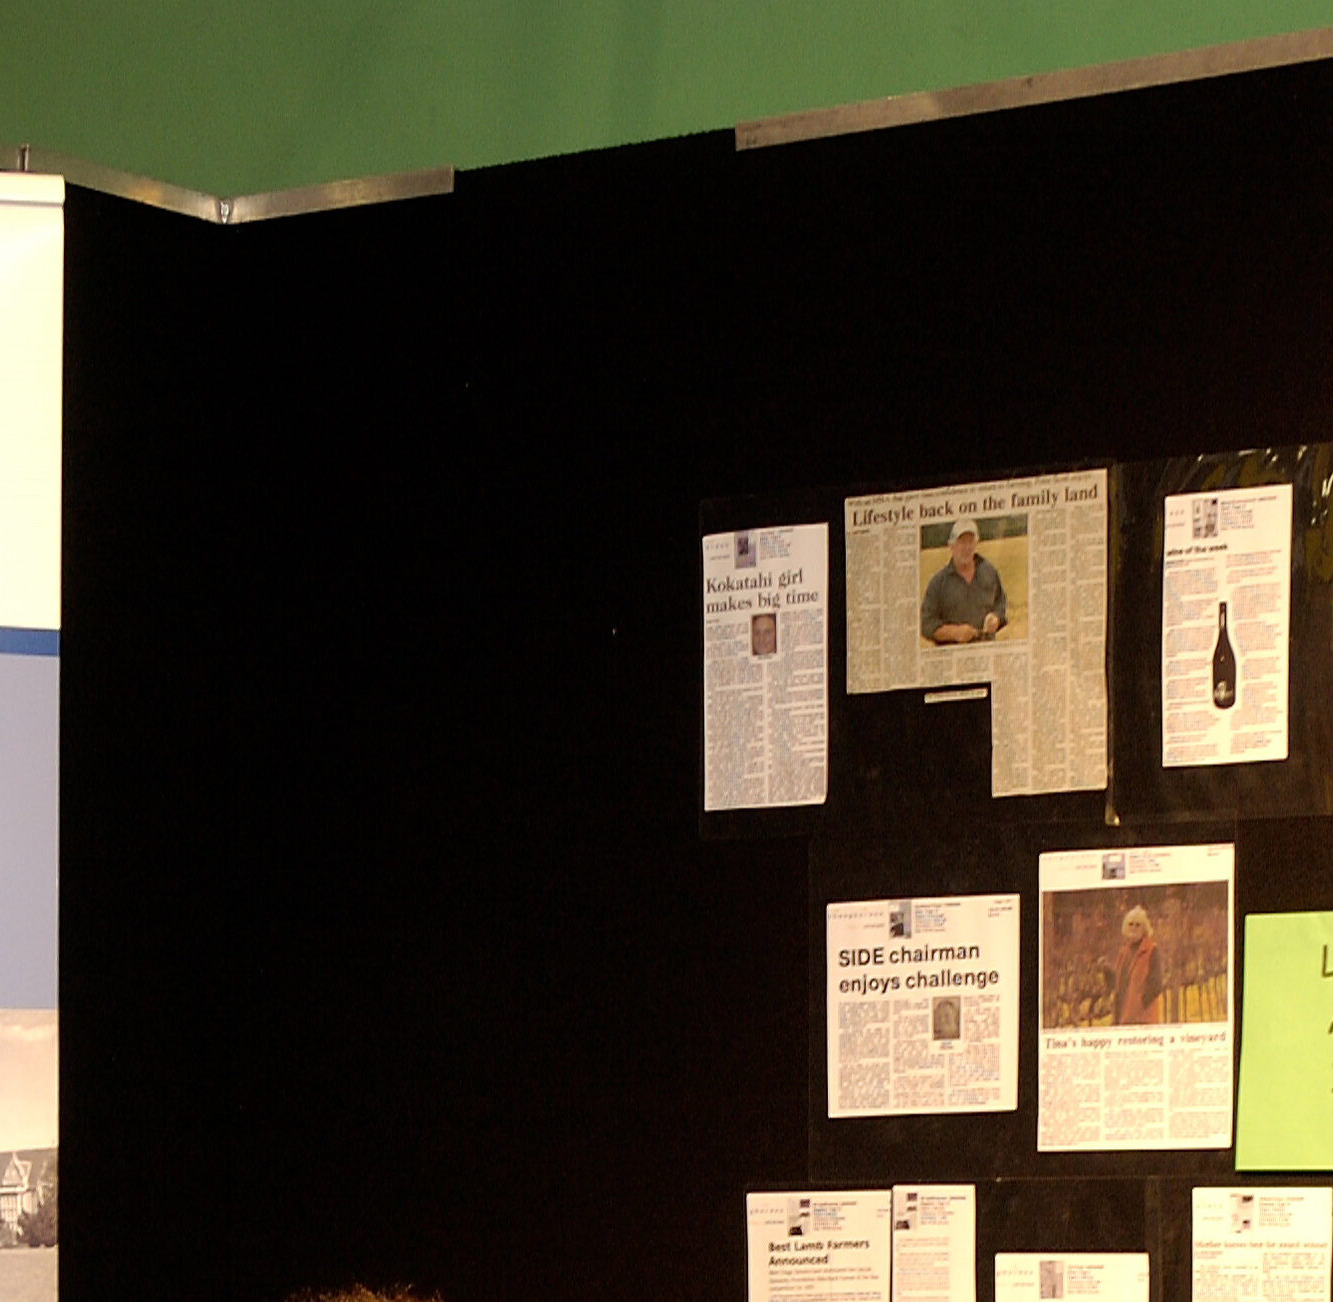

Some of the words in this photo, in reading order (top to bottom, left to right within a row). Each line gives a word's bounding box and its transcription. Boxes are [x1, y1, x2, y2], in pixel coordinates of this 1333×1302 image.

[852, 504, 915, 527] Lifestyle
[919, 501, 954, 519] back
[958, 500, 978, 514] on
[982, 495, 1006, 511] the
[1010, 488, 1060, 509] family
[1064, 484, 1098, 503] land
[706, 571, 773, 594] Kokatahi
[778, 567, 804, 588] girl
[706, 595, 753, 614] makes
[757, 591, 781, 609] big
[785, 589, 819, 605] time
[838, 946, 885, 967] SIDE
[889, 944, 981, 965] chairman
[838, 974, 901, 996] enjoys
[905, 968, 1000, 990] challenge
